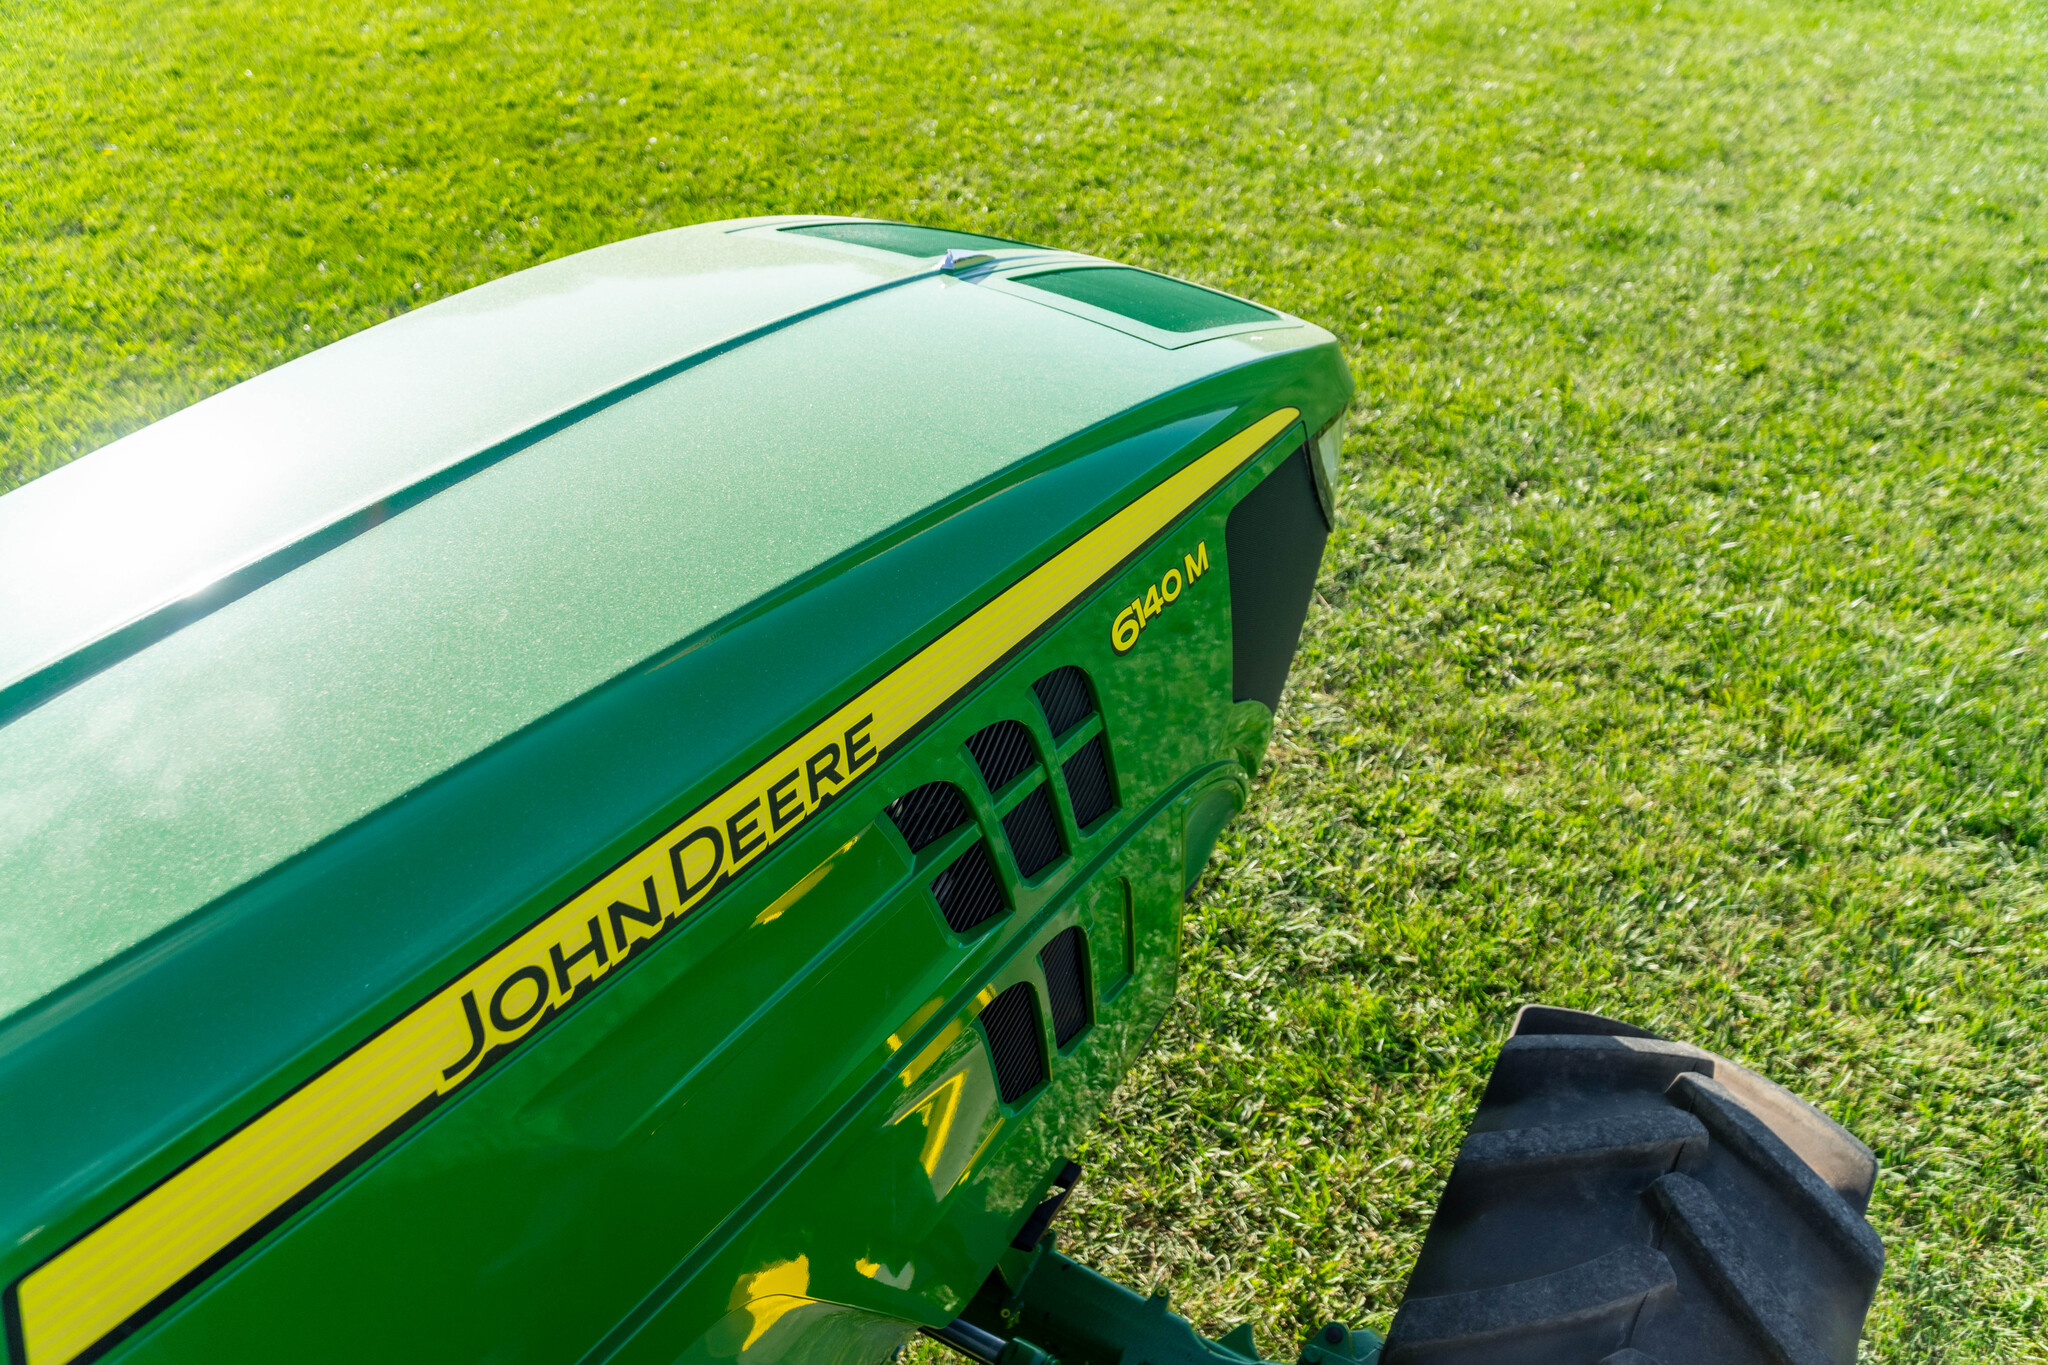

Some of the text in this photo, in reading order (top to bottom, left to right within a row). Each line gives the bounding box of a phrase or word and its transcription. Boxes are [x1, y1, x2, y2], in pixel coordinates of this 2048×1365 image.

[1110, 540, 1209, 655] 6140 M
[441, 712, 877, 1082] JOHN DEERE
